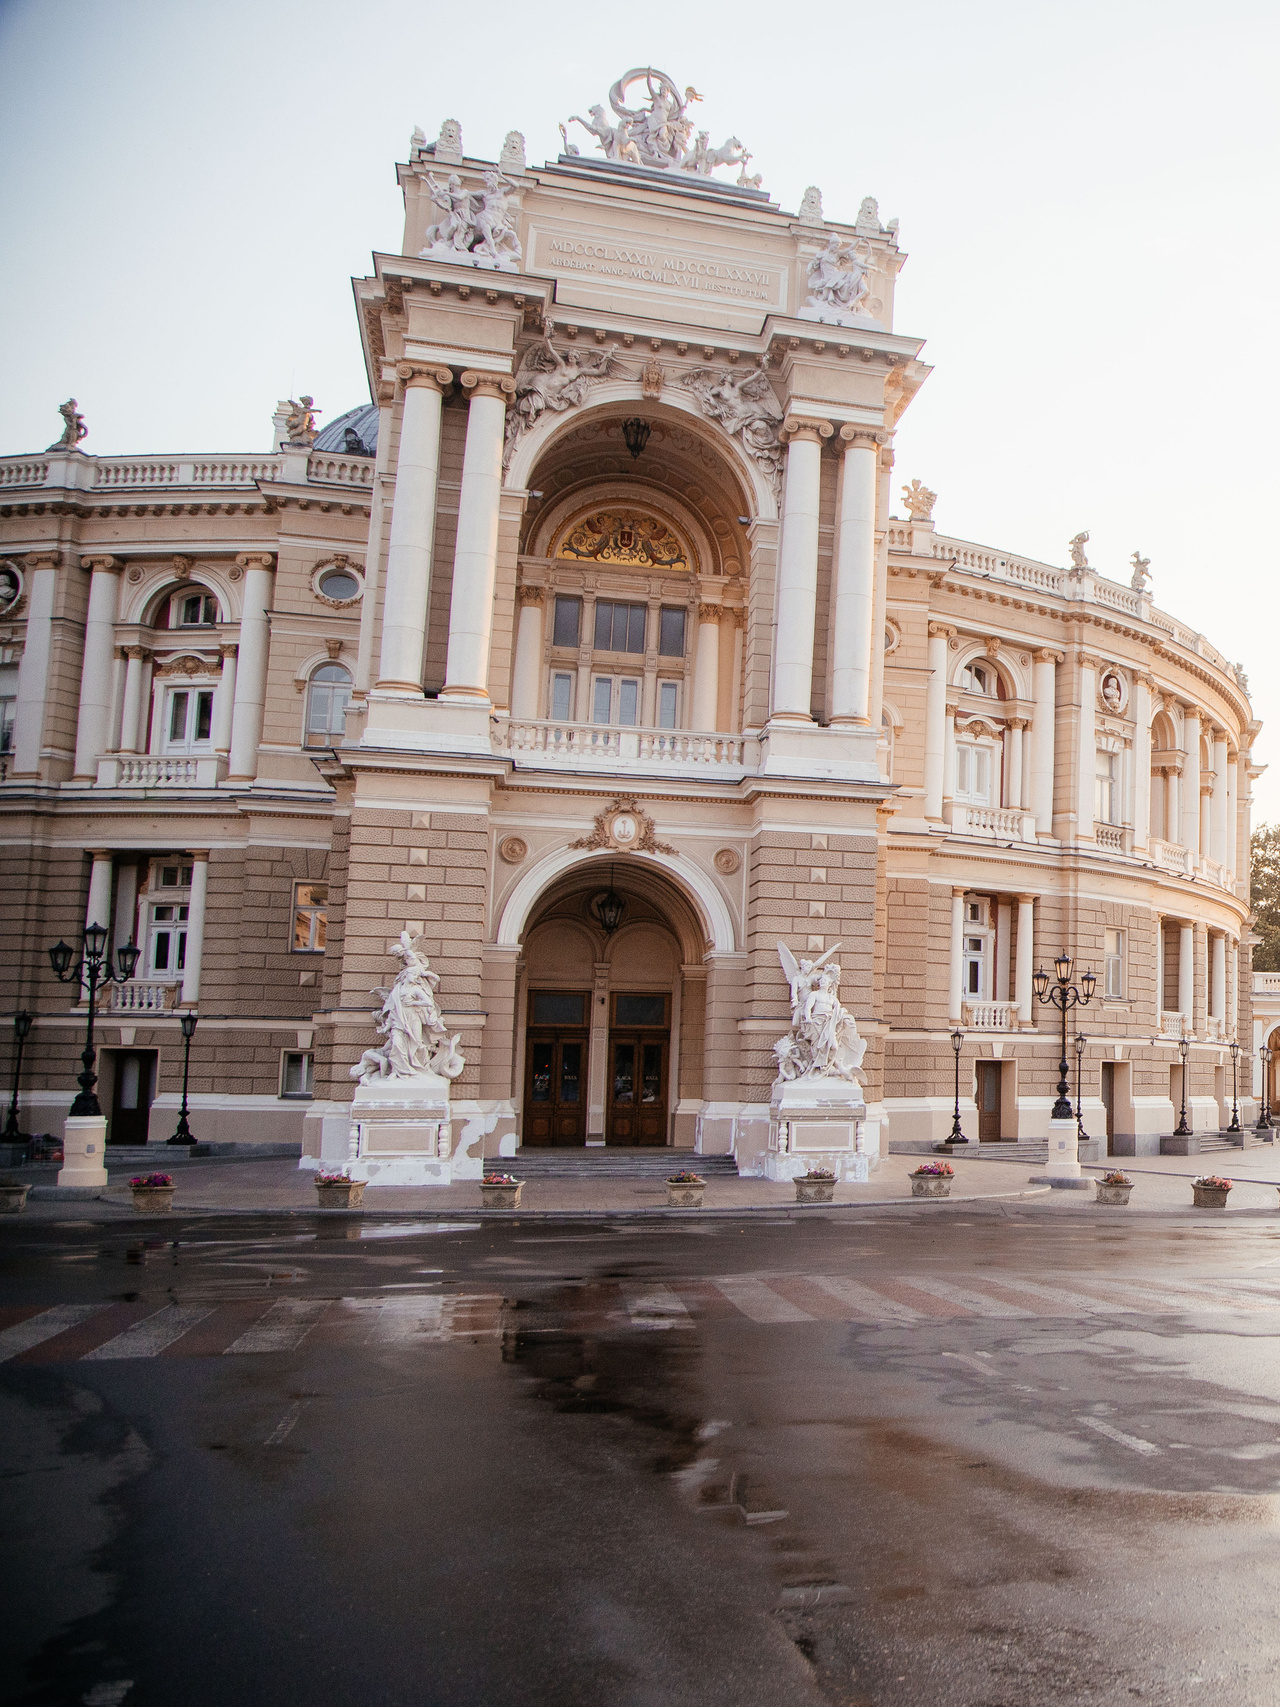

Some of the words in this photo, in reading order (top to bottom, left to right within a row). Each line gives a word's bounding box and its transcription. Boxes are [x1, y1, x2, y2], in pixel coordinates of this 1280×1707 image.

[550, 240, 657, 266] MDCCCLXXXIV
[663, 260, 770, 286] MDCCCLXXXVII
[629, 267, 699, 289] MCMLXVII
